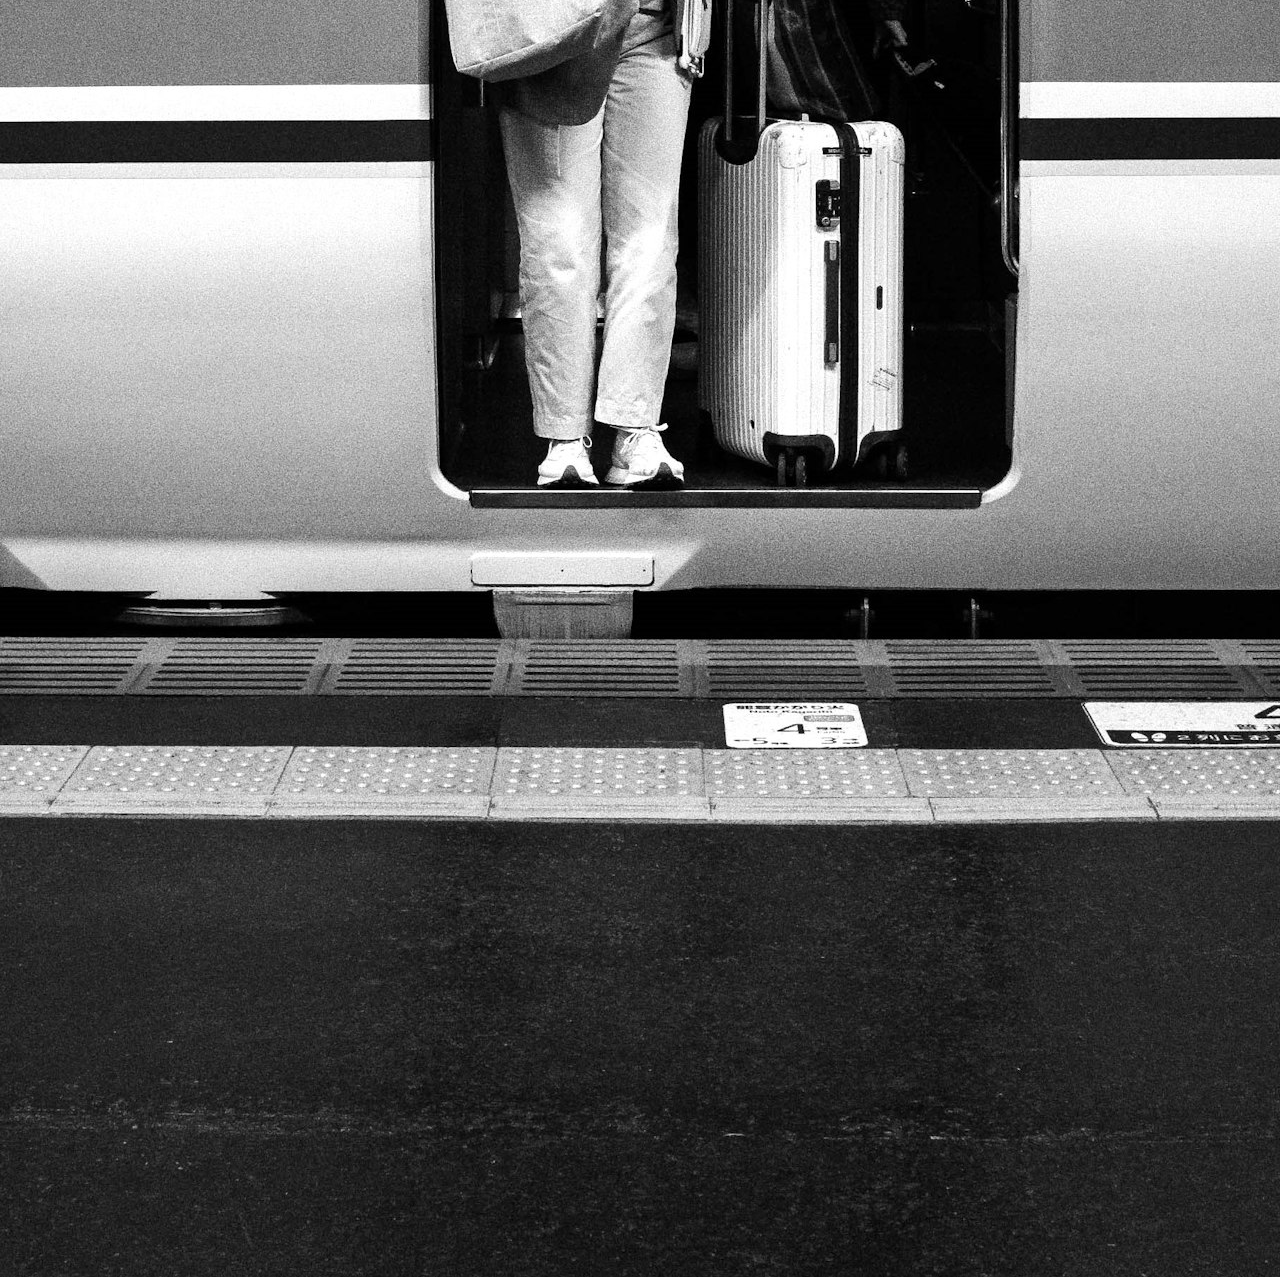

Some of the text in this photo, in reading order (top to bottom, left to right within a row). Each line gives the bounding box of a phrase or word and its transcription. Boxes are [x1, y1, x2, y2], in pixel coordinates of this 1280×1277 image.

[777, 723, 811, 735] 4
[753, 737, 768, 745] 5
[821, 737, 837, 745] 3
